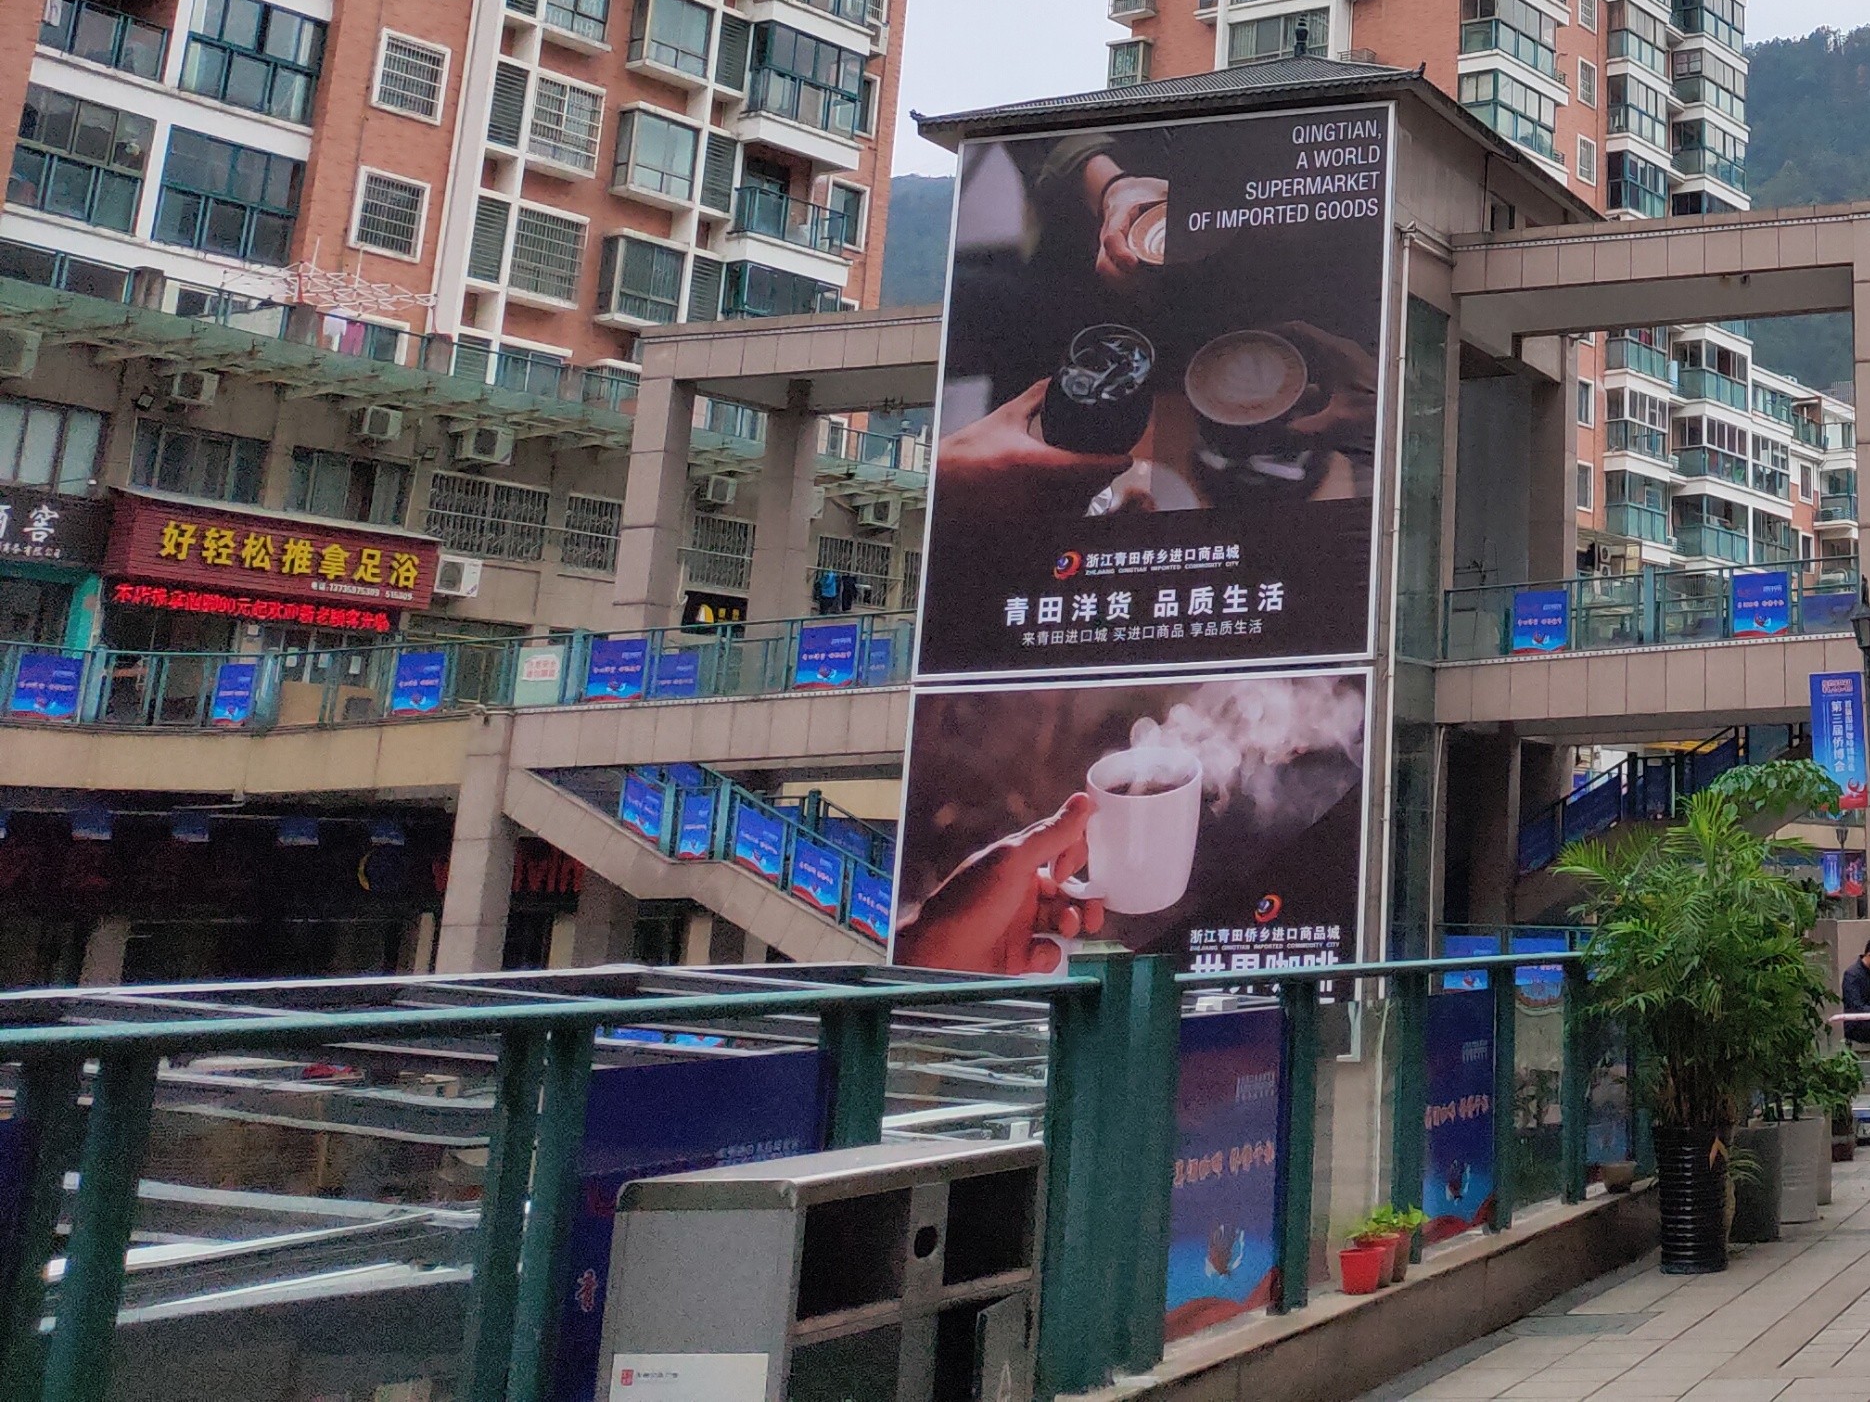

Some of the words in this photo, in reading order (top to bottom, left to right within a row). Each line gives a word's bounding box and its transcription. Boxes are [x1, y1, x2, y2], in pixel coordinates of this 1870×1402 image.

[1292, 120, 1382, 144] QINGTIAN,
[1296, 152, 1308, 170] A
[1314, 145, 1380, 168] WORLD
[1245, 171, 1380, 200] SUPERMARKET
[1188, 211, 1211, 232] OF
[1216, 204, 1309, 229] IMPORTED
[1315, 198, 1379, 221] GOODS
[160, 520, 421, 589] 好轻松推拿足浴
[1085, 544, 1240, 568] 浙江青田侨乡进口商品城
[1004, 591, 1131, 626] 青田洋货
[1153, 582, 1285, 618] 品质生活
[1022, 629, 1108, 646] 来青田进口城
[1113, 623, 1184, 642] 买进口商品
[1190, 619, 1263, 636] 享品质生活
[1831, 700, 1845, 773] 第三届侨博会
[1190, 925, 1341, 944] 浙江青田侨乡进口商品城
